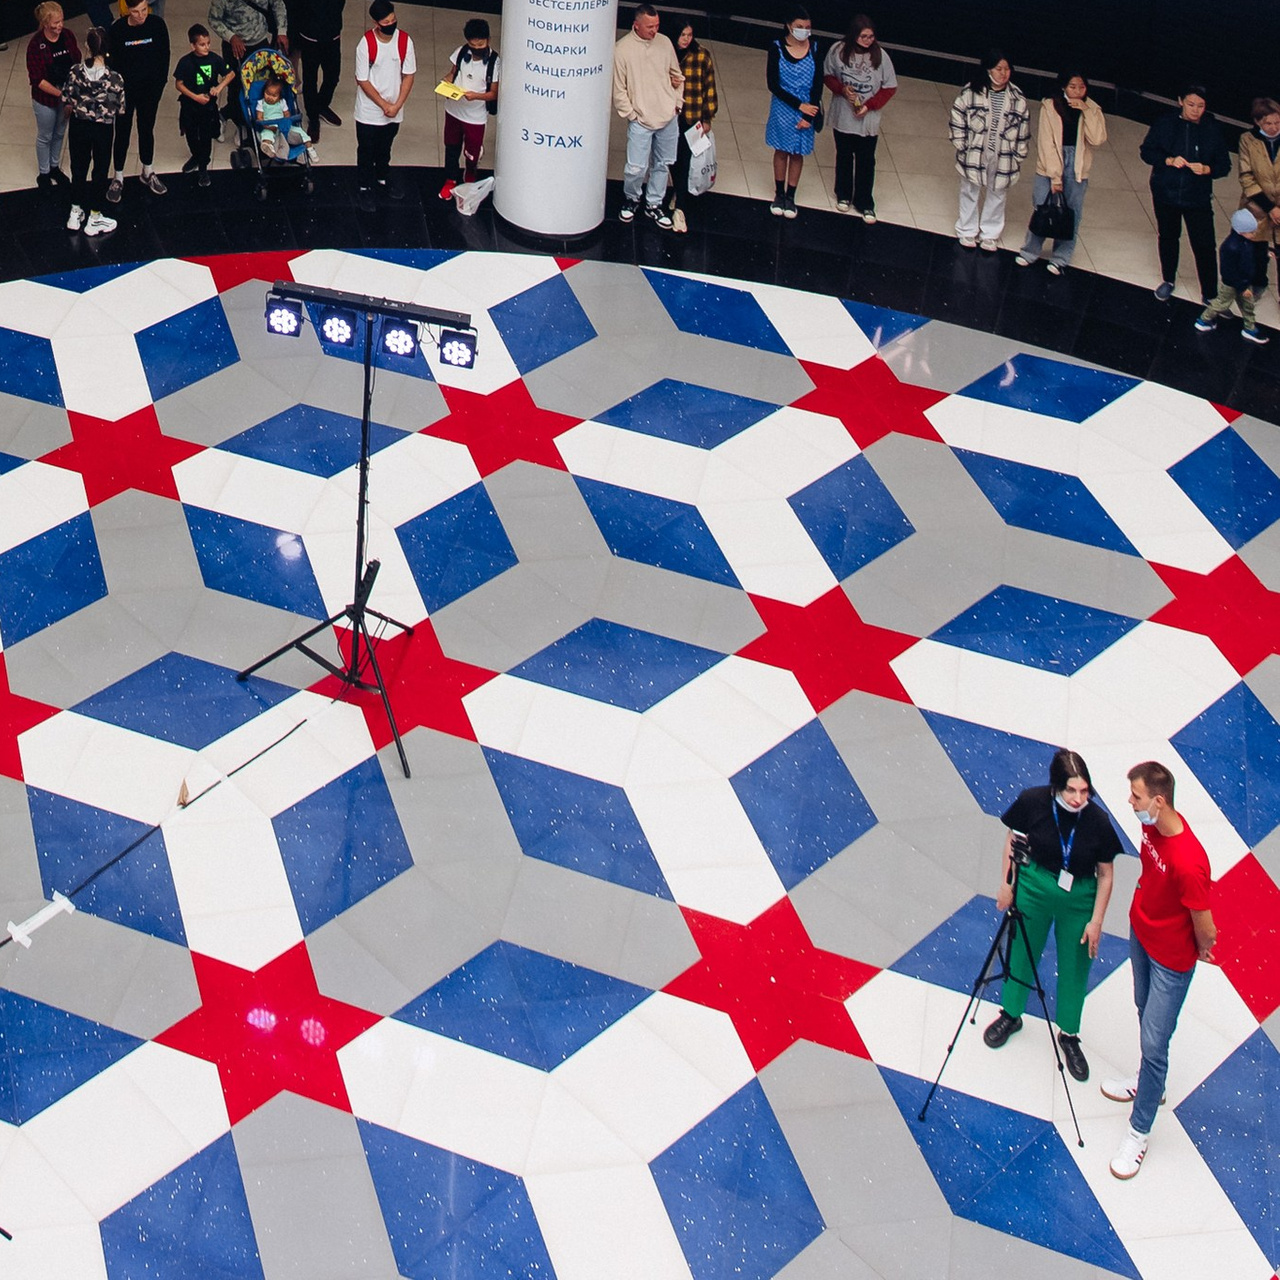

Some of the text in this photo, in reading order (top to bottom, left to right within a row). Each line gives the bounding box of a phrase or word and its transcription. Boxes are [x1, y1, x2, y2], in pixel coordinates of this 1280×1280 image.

[527, 17, 590, 33] НОВИНКИ
[526, 39, 587, 56] ПОДАРКИ
[525, 61, 604, 78] КАНЦЕЛЯРИЯ
[524, 83, 566, 99] КНИГИ
[521, 128, 583, 148] 3 ЭТАЖ
